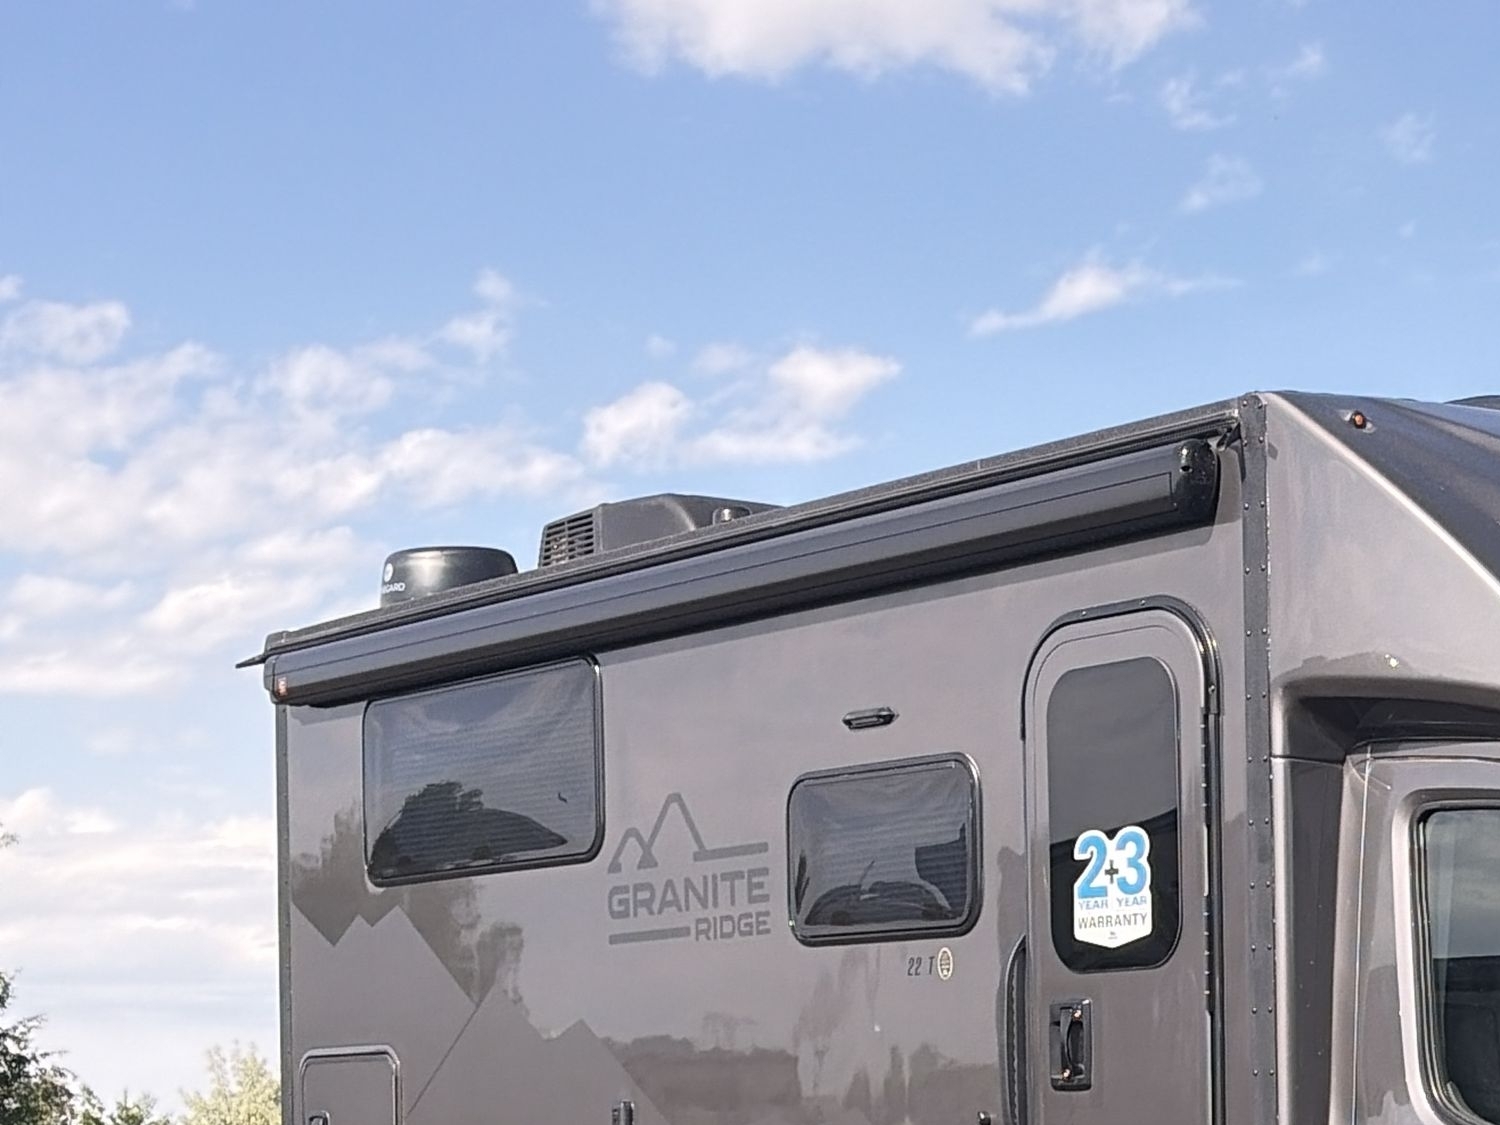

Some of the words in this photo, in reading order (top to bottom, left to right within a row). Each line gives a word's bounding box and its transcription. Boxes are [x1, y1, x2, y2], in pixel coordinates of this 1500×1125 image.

[607, 866, 771, 920] GRANITE
[1078, 899, 1109, 911] YEAR
[1116, 895, 1148, 907] YEAR
[694, 910, 772, 942] RIDGE
[1078, 912, 1148, 930] WARRANTY
[907, 956, 922, 977] 22
